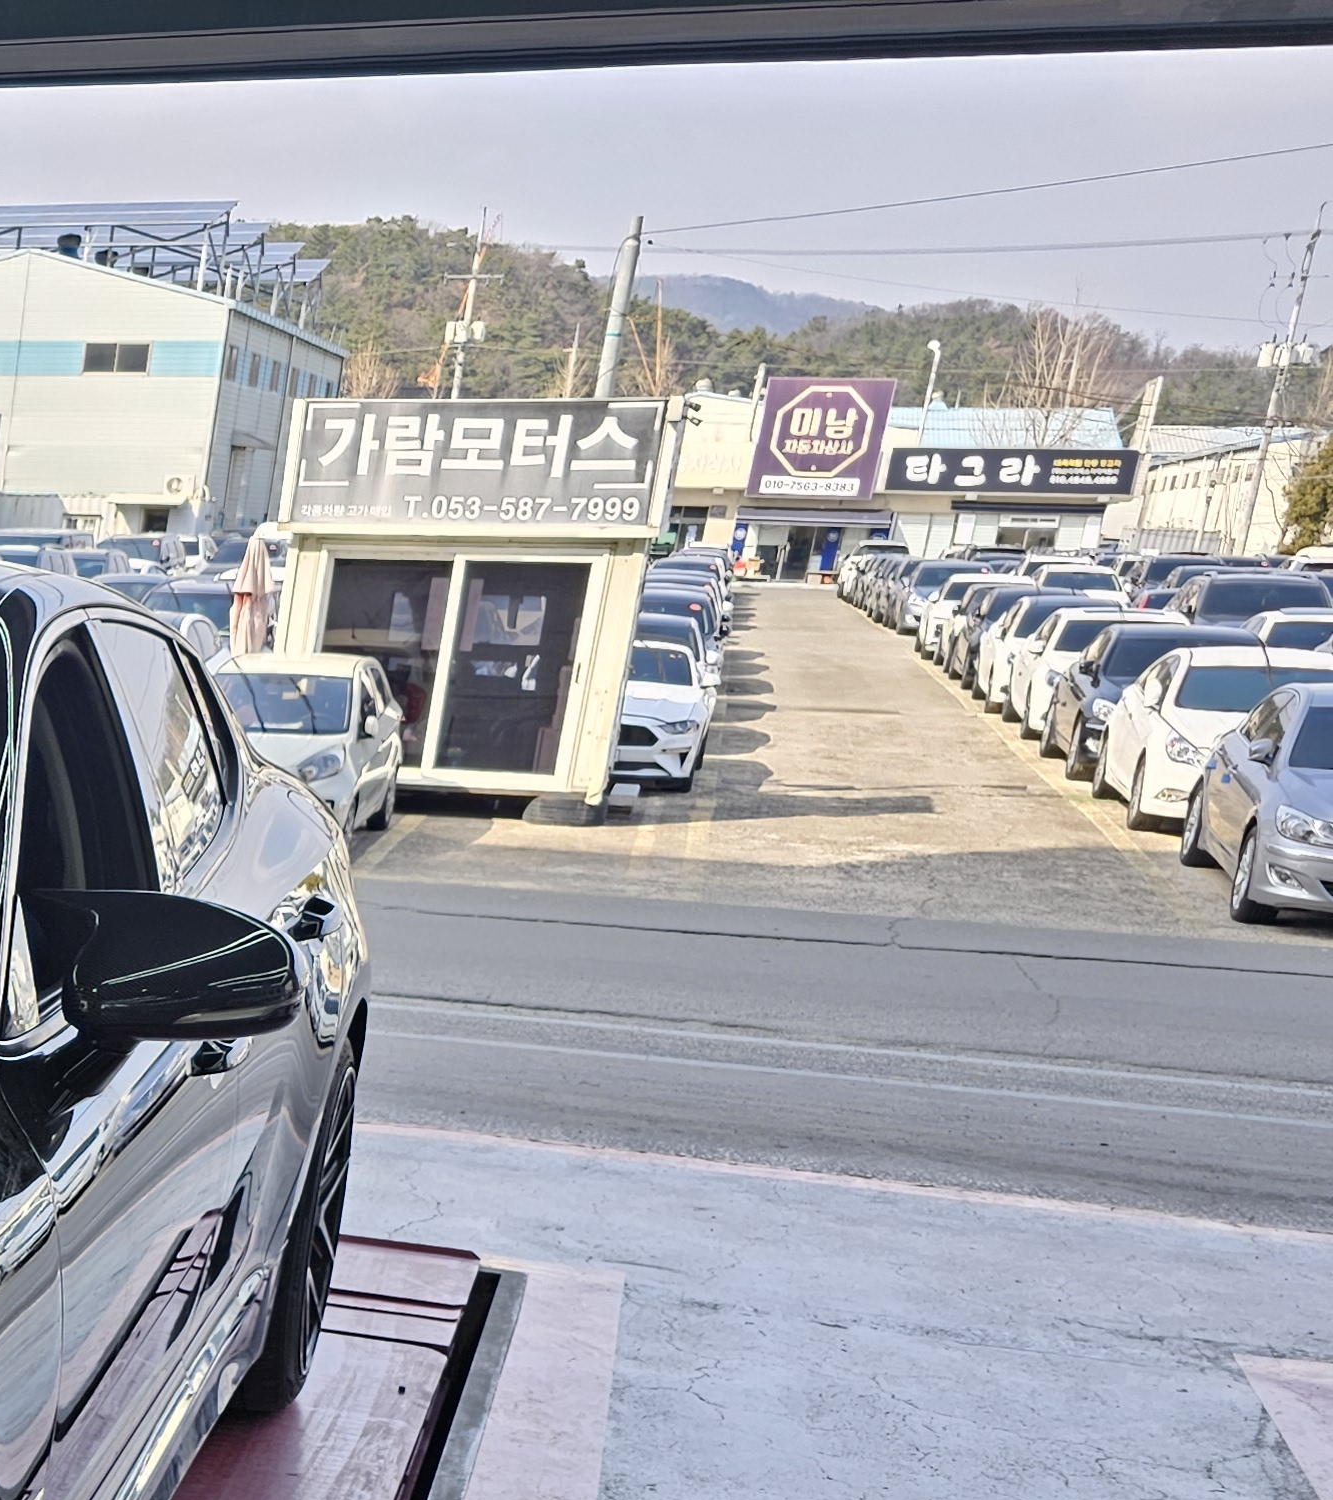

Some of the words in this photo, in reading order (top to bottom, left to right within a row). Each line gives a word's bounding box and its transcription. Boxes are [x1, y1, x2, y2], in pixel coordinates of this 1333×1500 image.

[318, 413, 639, 478] 가람모터스
[781, 439, 855, 456] 자동차상사
[764, 479, 856, 492] 010-7563-8383
[403, 495, 640, 521] T.053-587-7999
